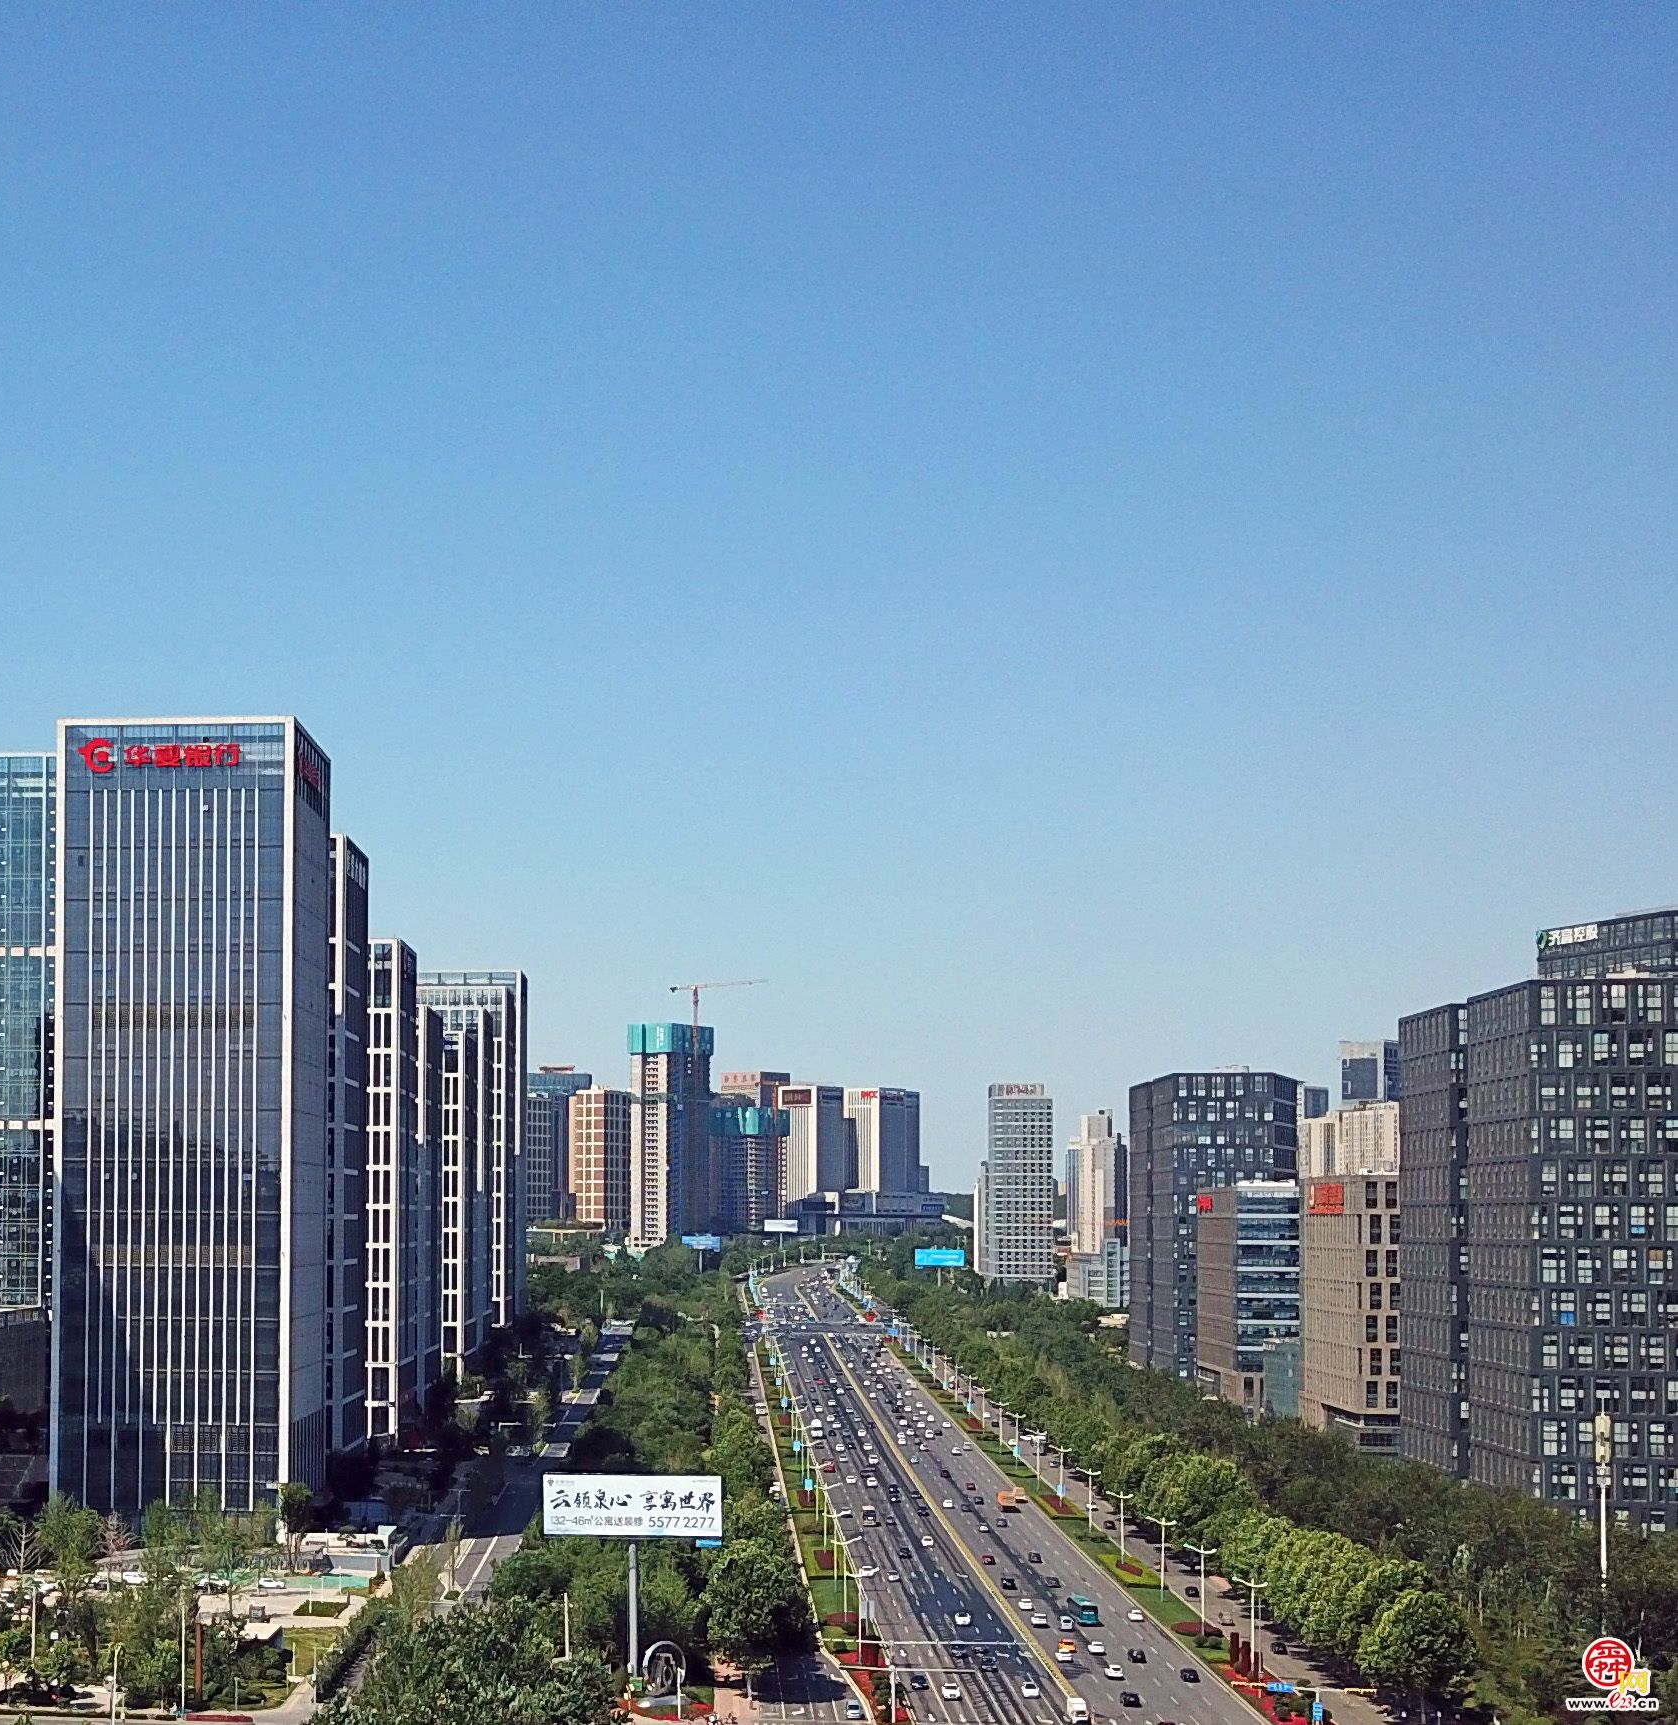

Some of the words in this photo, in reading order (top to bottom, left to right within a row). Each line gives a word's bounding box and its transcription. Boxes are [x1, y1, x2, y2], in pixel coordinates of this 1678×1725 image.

[125, 743, 241, 768] 华夏银行
[649, 1516, 680, 1528] 5577
[683, 1516, 715, 1528] 2277
